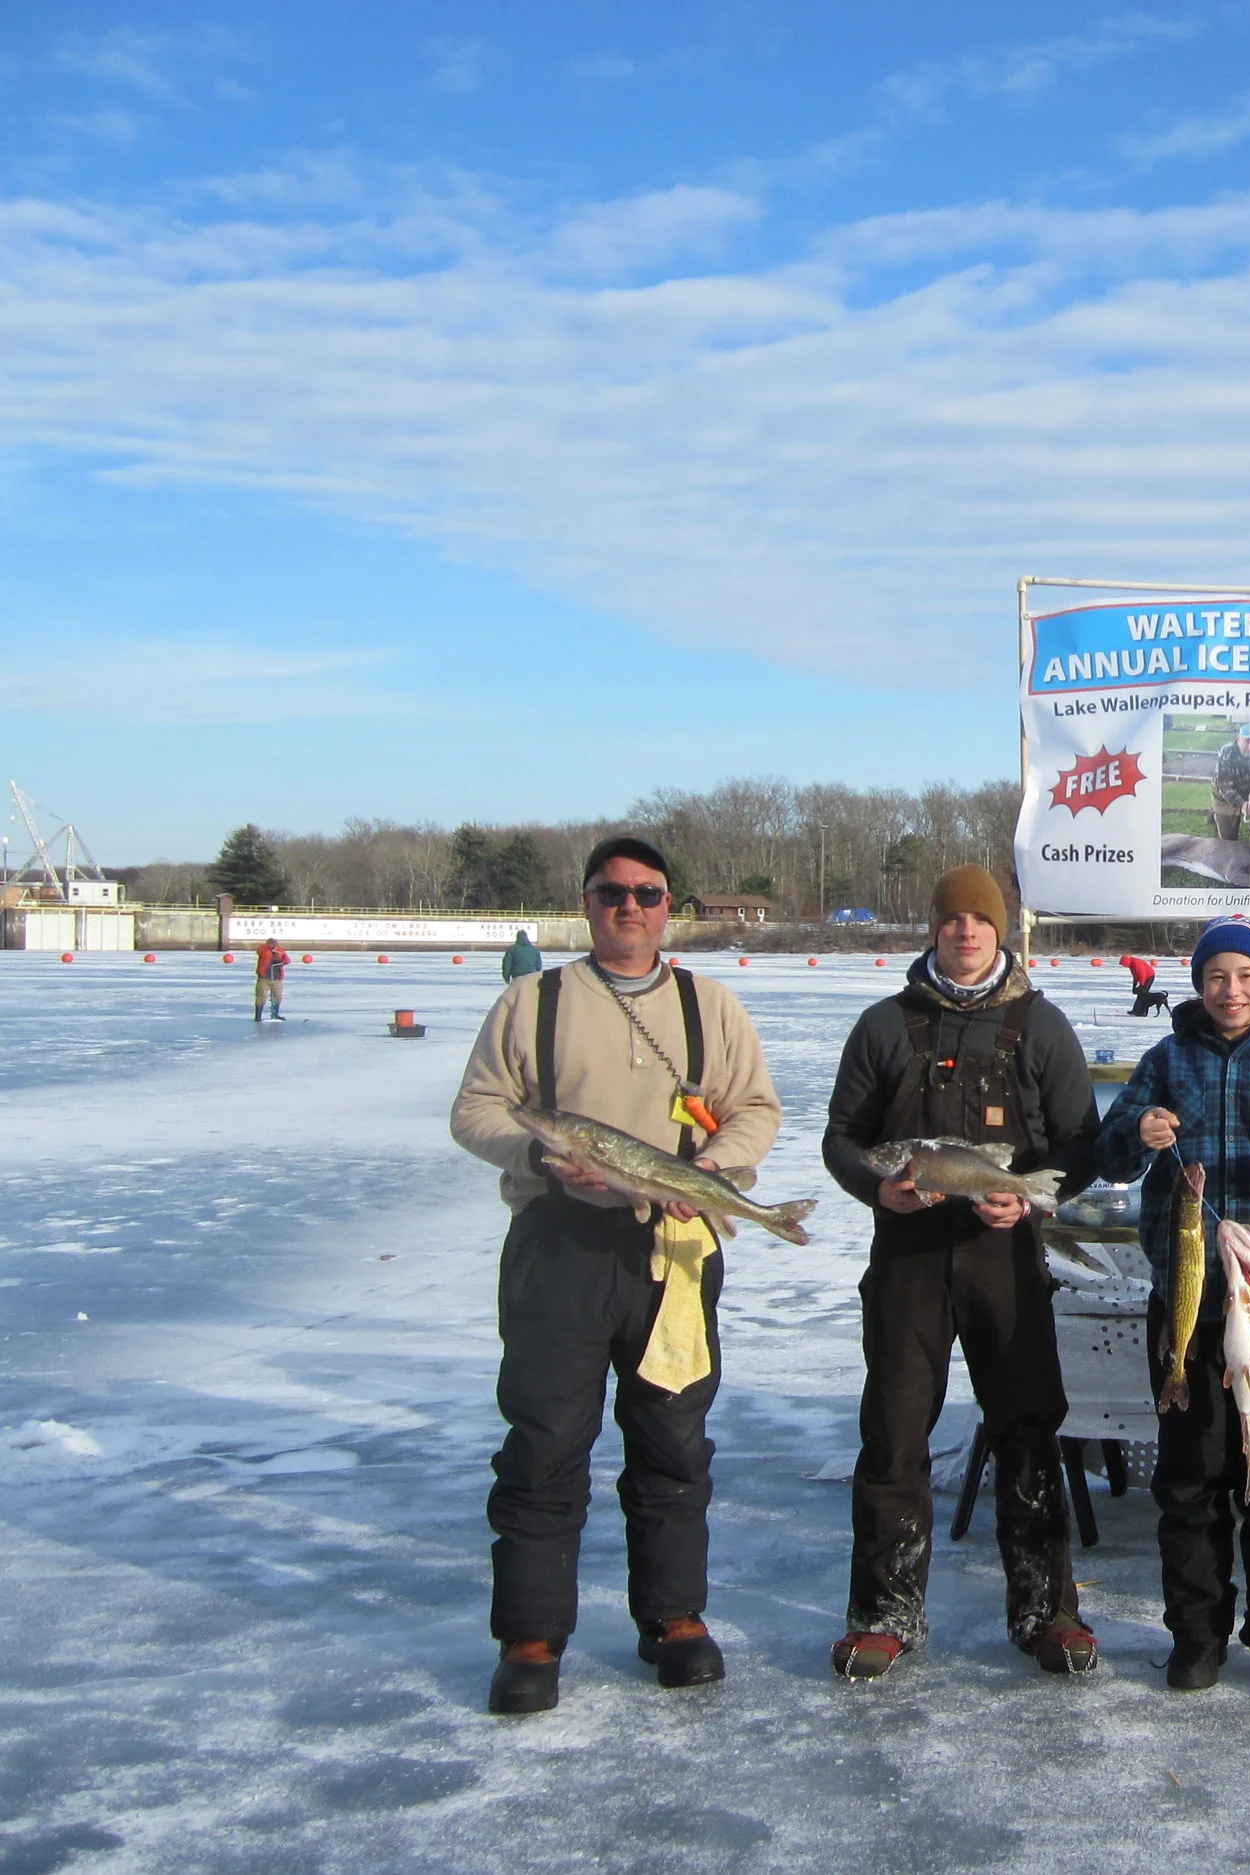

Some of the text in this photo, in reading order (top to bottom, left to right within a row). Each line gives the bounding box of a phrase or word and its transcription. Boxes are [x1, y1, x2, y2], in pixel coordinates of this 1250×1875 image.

[1043, 646, 1188, 683] ANNUAL
[1197, 643, 1250, 672] ICE
[1054, 701, 1097, 717] Lake
[1100, 691, 1240, 714] Wallenpaupack,
[1065, 760, 1122, 799] FREE
[1041, 843, 1135, 863] Cash Prizes
[1152, 894, 1205, 906] Donation
[1207, 894, 1223, 907] for
[236, 920, 297, 928] KEEP BACK
